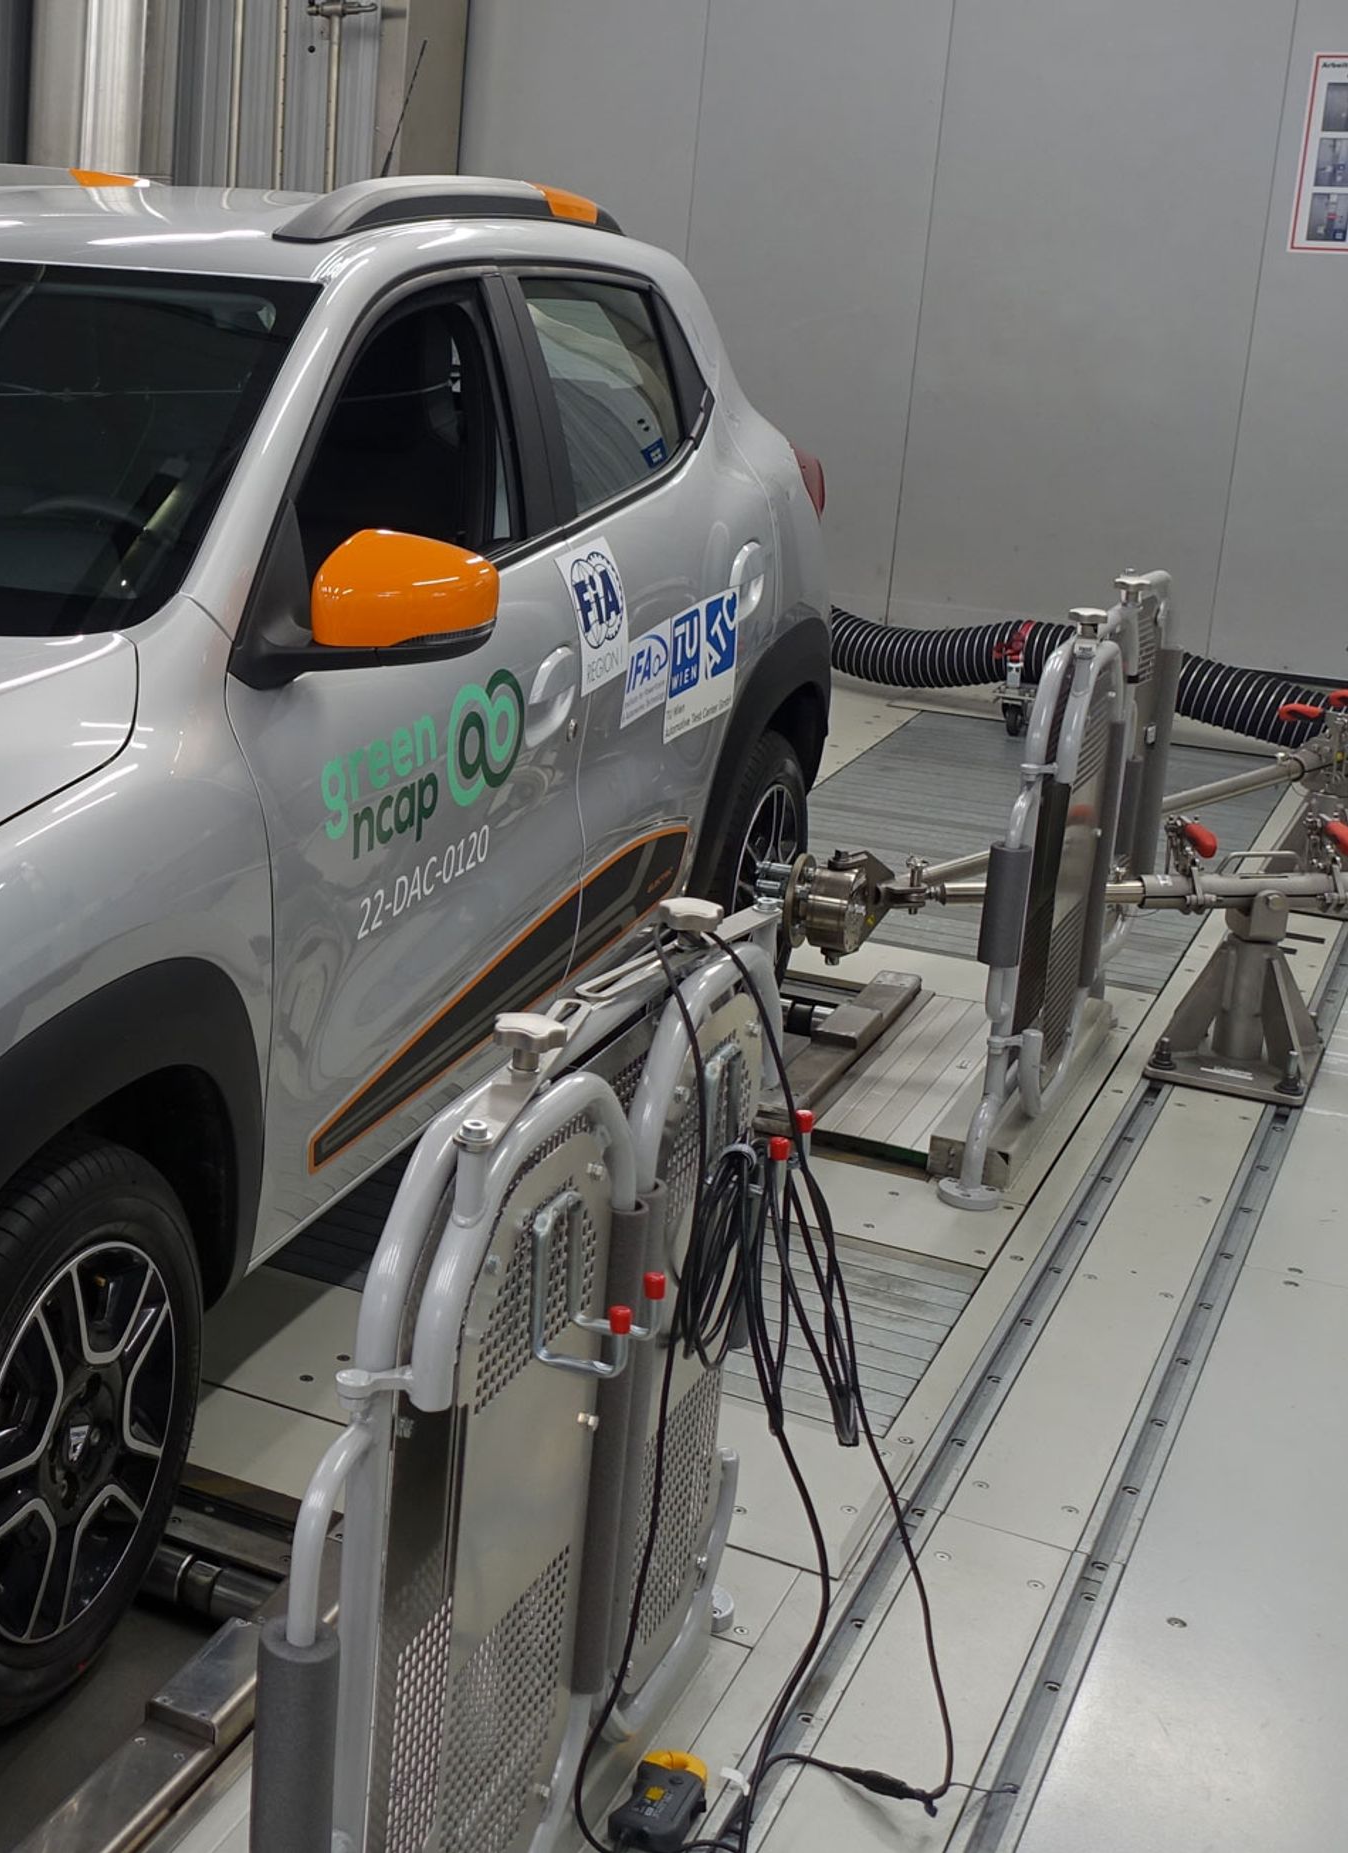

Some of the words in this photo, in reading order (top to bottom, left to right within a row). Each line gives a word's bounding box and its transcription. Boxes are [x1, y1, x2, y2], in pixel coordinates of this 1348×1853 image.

[675, 618, 698, 664] TU
[586, 651, 619, 683] REGION
[626, 646, 652, 694] IFA
[671, 664, 698, 691] WIEN
[321, 713, 437, 840] green
[353, 771, 439, 860] ncap
[357, 824, 489, 940] 22-DAC-0120
